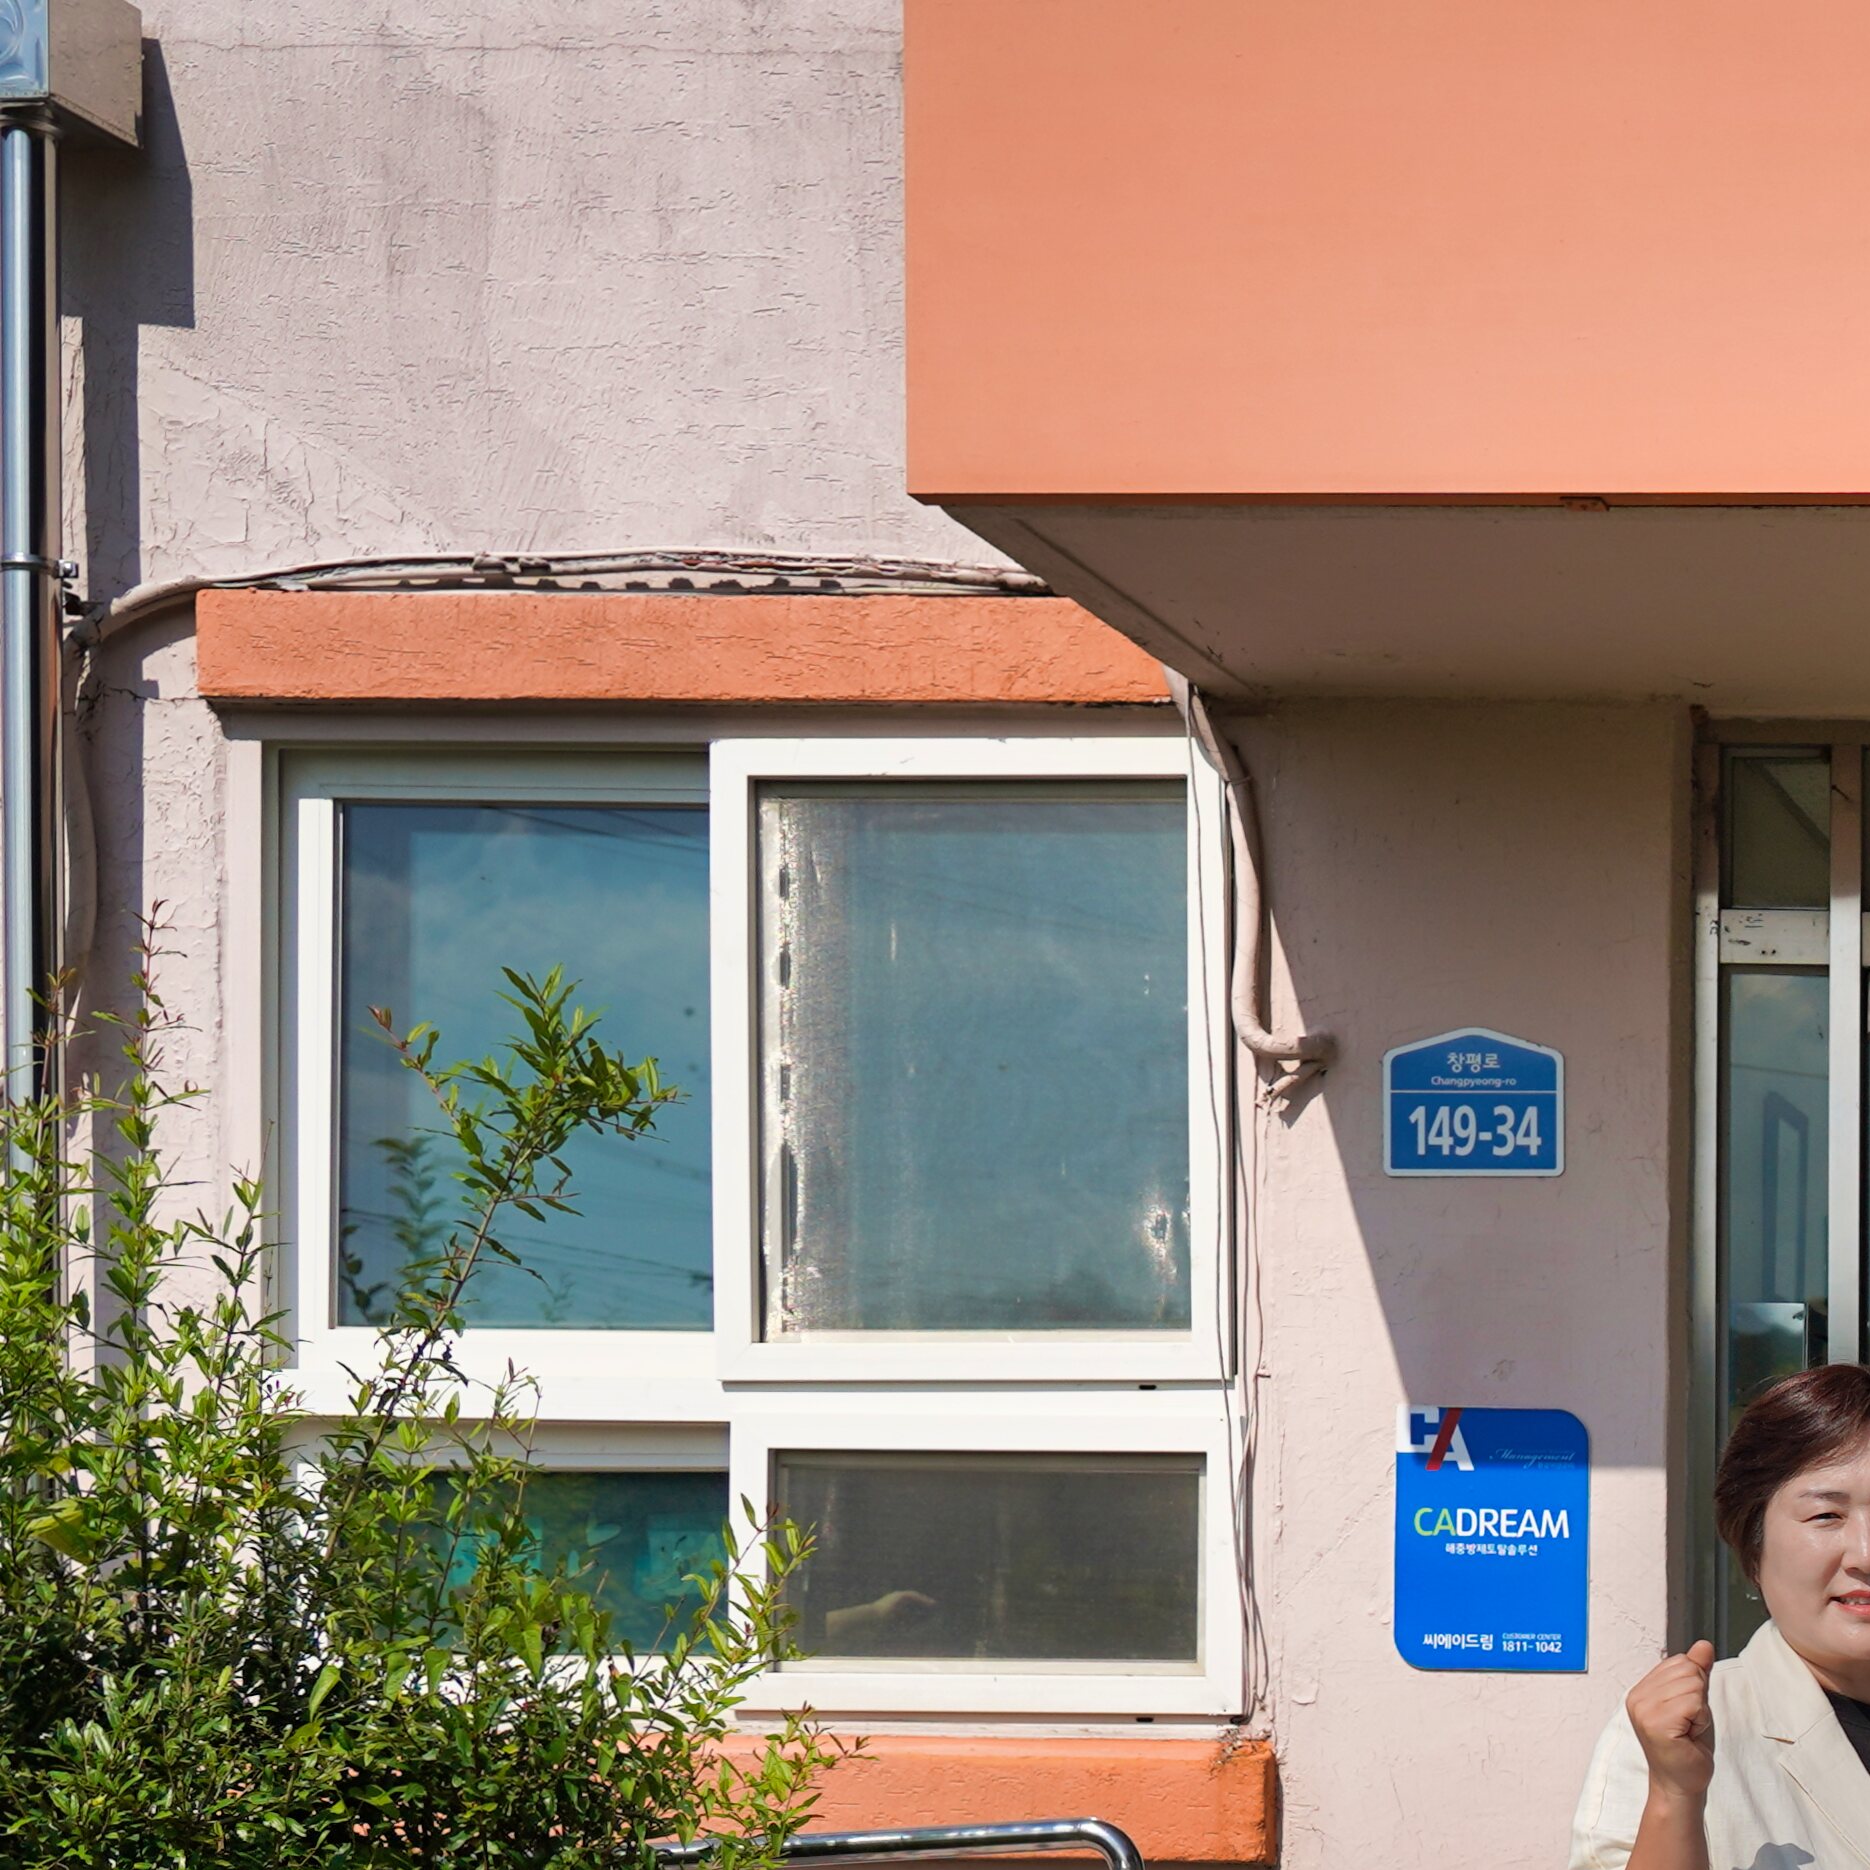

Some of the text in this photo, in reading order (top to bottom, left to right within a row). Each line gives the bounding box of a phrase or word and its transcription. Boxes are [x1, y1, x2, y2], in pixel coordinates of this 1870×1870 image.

[1447, 1052, 1500, 1073] 창평로
[1431, 1076, 1517, 1087] Changpyeong-ro
[1409, 1105, 1541, 1156] 149-34
[1414, 1507, 1569, 1538] CADREAM
[1423, 1633, 1493, 1650] 씨에이드림
[1503, 1640, 1561, 1653] 1811-1042
